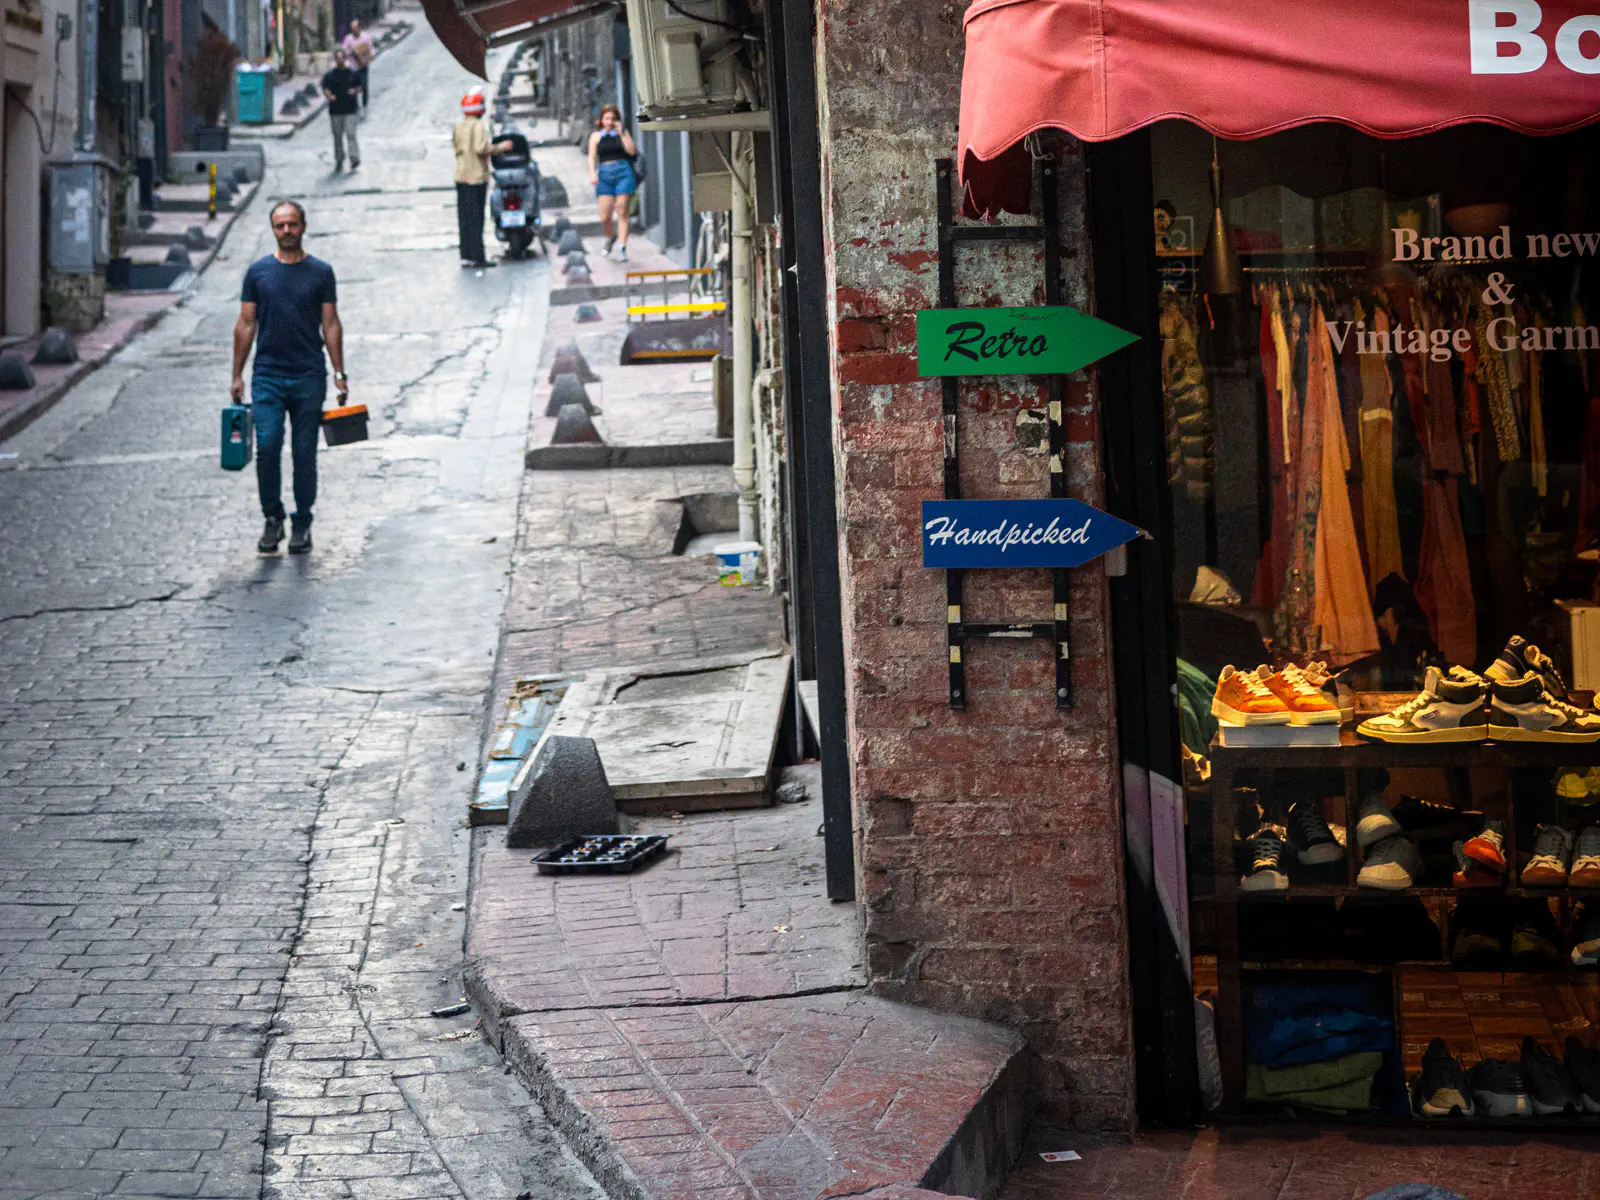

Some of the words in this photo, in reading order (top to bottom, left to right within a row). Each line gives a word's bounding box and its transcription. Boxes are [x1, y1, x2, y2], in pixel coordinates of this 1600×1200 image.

[1391, 226, 1513, 261] Brand
[1526, 232, 1600, 258] new
[1482, 271, 1516, 306] &
[944, 321, 1048, 362] Retro
[1325, 321, 1472, 362] Vintage
[1486, 316, 1600, 351] Garm
[925, 517, 1091, 551] Handpicked
